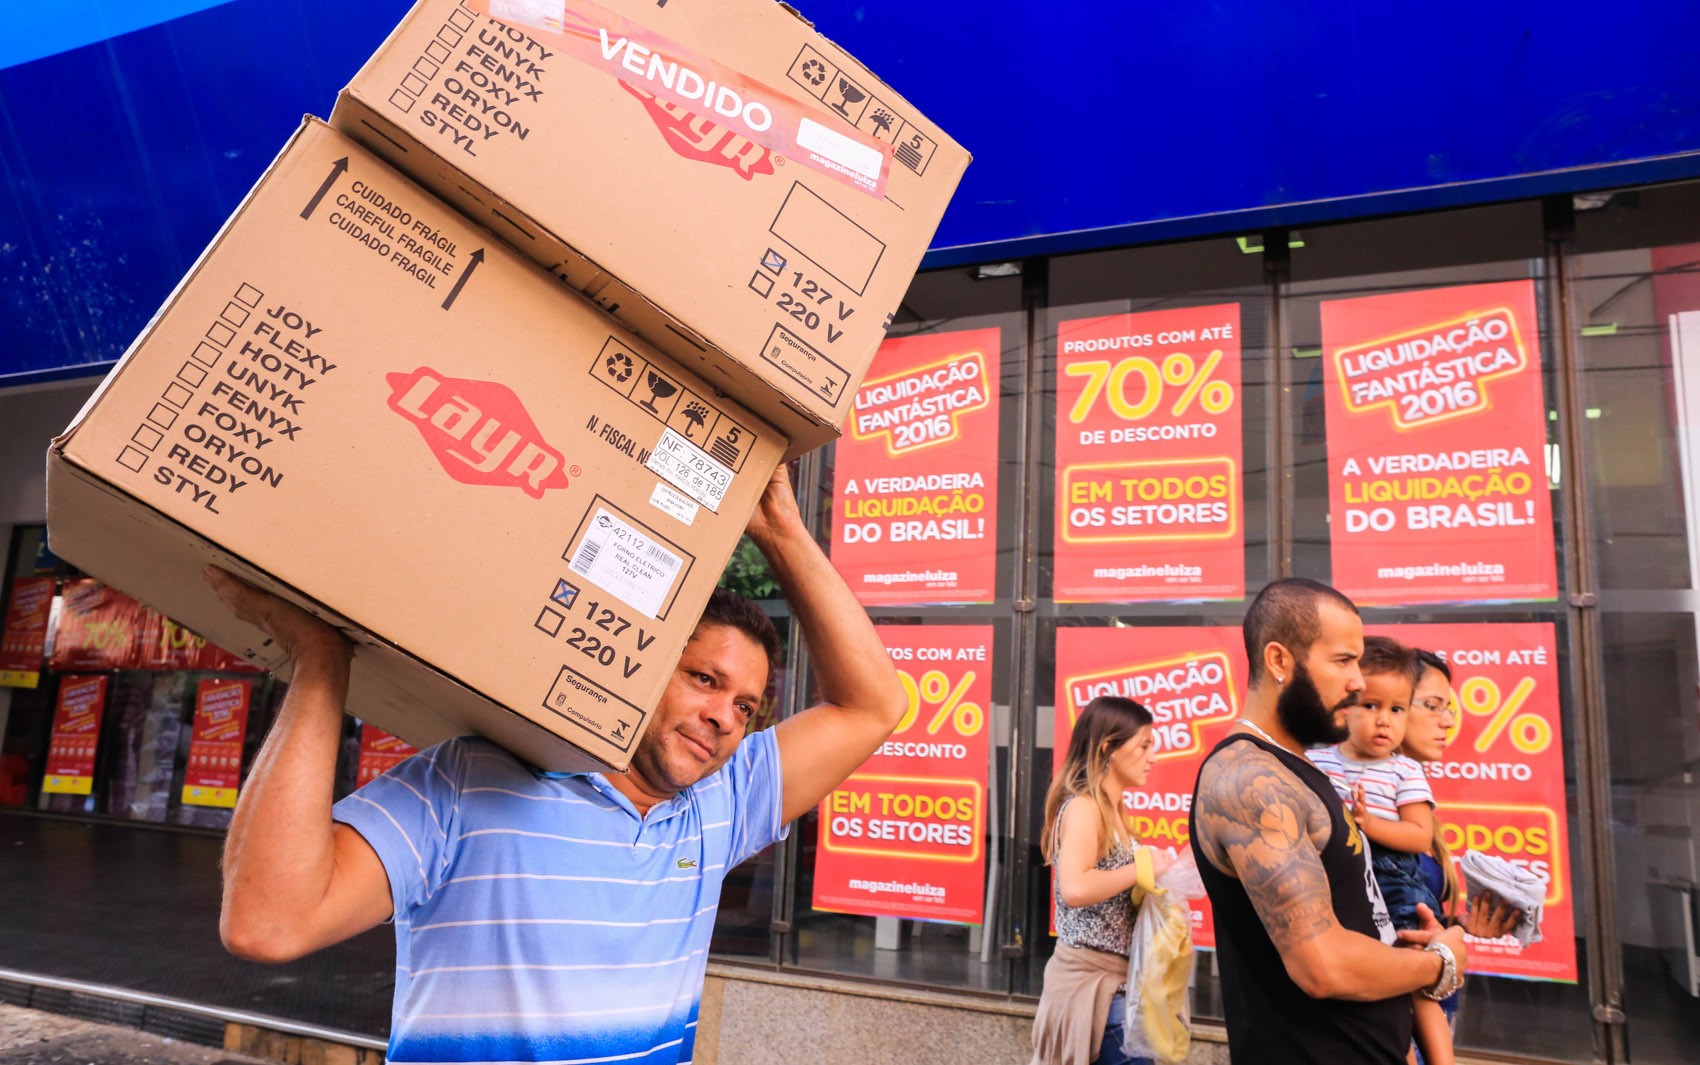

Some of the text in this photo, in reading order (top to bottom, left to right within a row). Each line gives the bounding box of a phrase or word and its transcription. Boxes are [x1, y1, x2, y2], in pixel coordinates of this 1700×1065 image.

[478, 29, 545, 82] UNYK
[455, 60, 520, 107] FOXY
[466, 44, 544, 103] FENYX
[599, 28, 772, 132] VENDIDO
[431, 93, 499, 142] REDY
[444, 77, 530, 141] ORYON
[420, 110, 477, 157] STYL
[909, 134, 923, 150] 5
[810, 153, 878, 188] magazineluiza
[336, 193, 454, 276] CAREFUL FRAGILE
[351, 181, 457, 258] CUIDADO FRÁGIL
[329, 212, 436, 289] CUIDADO FRAGIL
[792, 271, 855, 321] 127 V
[266, 305, 323, 339] JOY
[776, 292, 843, 344] 220 V
[253, 321, 338, 376] FLEXY
[779, 331, 817, 362] Segurança
[1064, 323, 1233, 353] PRODUTOS COM ATÉ
[1344, 318, 1508, 378] LIQUIDAÇÃO
[239, 340, 317, 391] HOTY
[781, 360, 813, 384] Compulsório
[1352, 347, 1516, 404] FANTÁSTICA
[226, 360, 306, 416] UNYK
[855, 361, 979, 411] LIQUIDAÇÃO
[1065, 349, 1234, 423] 70%
[1400, 381, 1477, 421] 2016
[197, 401, 273, 450] FOXY
[211, 381, 303, 442] FENYX
[858, 385, 983, 434] FANTÁSTICA
[586, 414, 597, 434] N.
[599, 424, 639, 459] FISCAL
[726, 427, 742, 444] 5
[894, 414, 951, 449] 2016
[1080, 423, 1217, 445] DE DESCONTO
[167, 443, 247, 494] REDY
[183, 424, 284, 488] ORYON
[688, 453, 727, 486] 78743
[1342, 447, 1529, 476] A VERDADEIRA
[153, 465, 220, 515] STYL
[675, 463, 691, 478] 126
[692, 476, 703, 487] de
[705, 484, 723, 501] 185
[844, 472, 984, 494] A VERDADEIRA
[1071, 475, 1227, 504] EM TODOS
[1344, 468, 1531, 504] LIQUIDAÇÃO
[844, 489, 984, 519] LIQUIDAÇÃO
[1070, 502, 1227, 527] OS SETORES
[1345, 500, 1535, 532] DO BRASIL!
[613, 527, 645, 551] 42112
[843, 518, 985, 544] DO BRASIL!
[613, 542, 665, 578] FORNO ELÉTRICO
[614, 553, 653, 580] REAL CLEAN
[621, 567, 638, 579] 127V
[863, 569, 958, 585] magazineluiza
[1093, 564, 1202, 580] magazineluiza
[1377, 562, 1504, 580] magazineluiza
[586, 601, 656, 652] 127 V
[566, 627, 642, 679] 220 V
[917, 648, 952, 660] COM
[956, 645, 985, 661] ATÉ
[1453, 650, 1500, 665] COM
[1506, 646, 1547, 665] ATÉ
[566, 675, 608, 704] Segurança
[1074, 661, 1223, 707] LIQUIDAÇÃO
[567, 706, 602, 730] Compulsório
[1143, 692, 1228, 723] STICA
[1424, 762, 1532, 781] SCONTO
[832, 791, 973, 820] EM TODOS
[832, 818, 972, 846] OS SETORES
[1440, 823, 1548, 855] ODOS
[849, 879, 946, 897] magazineluiza
